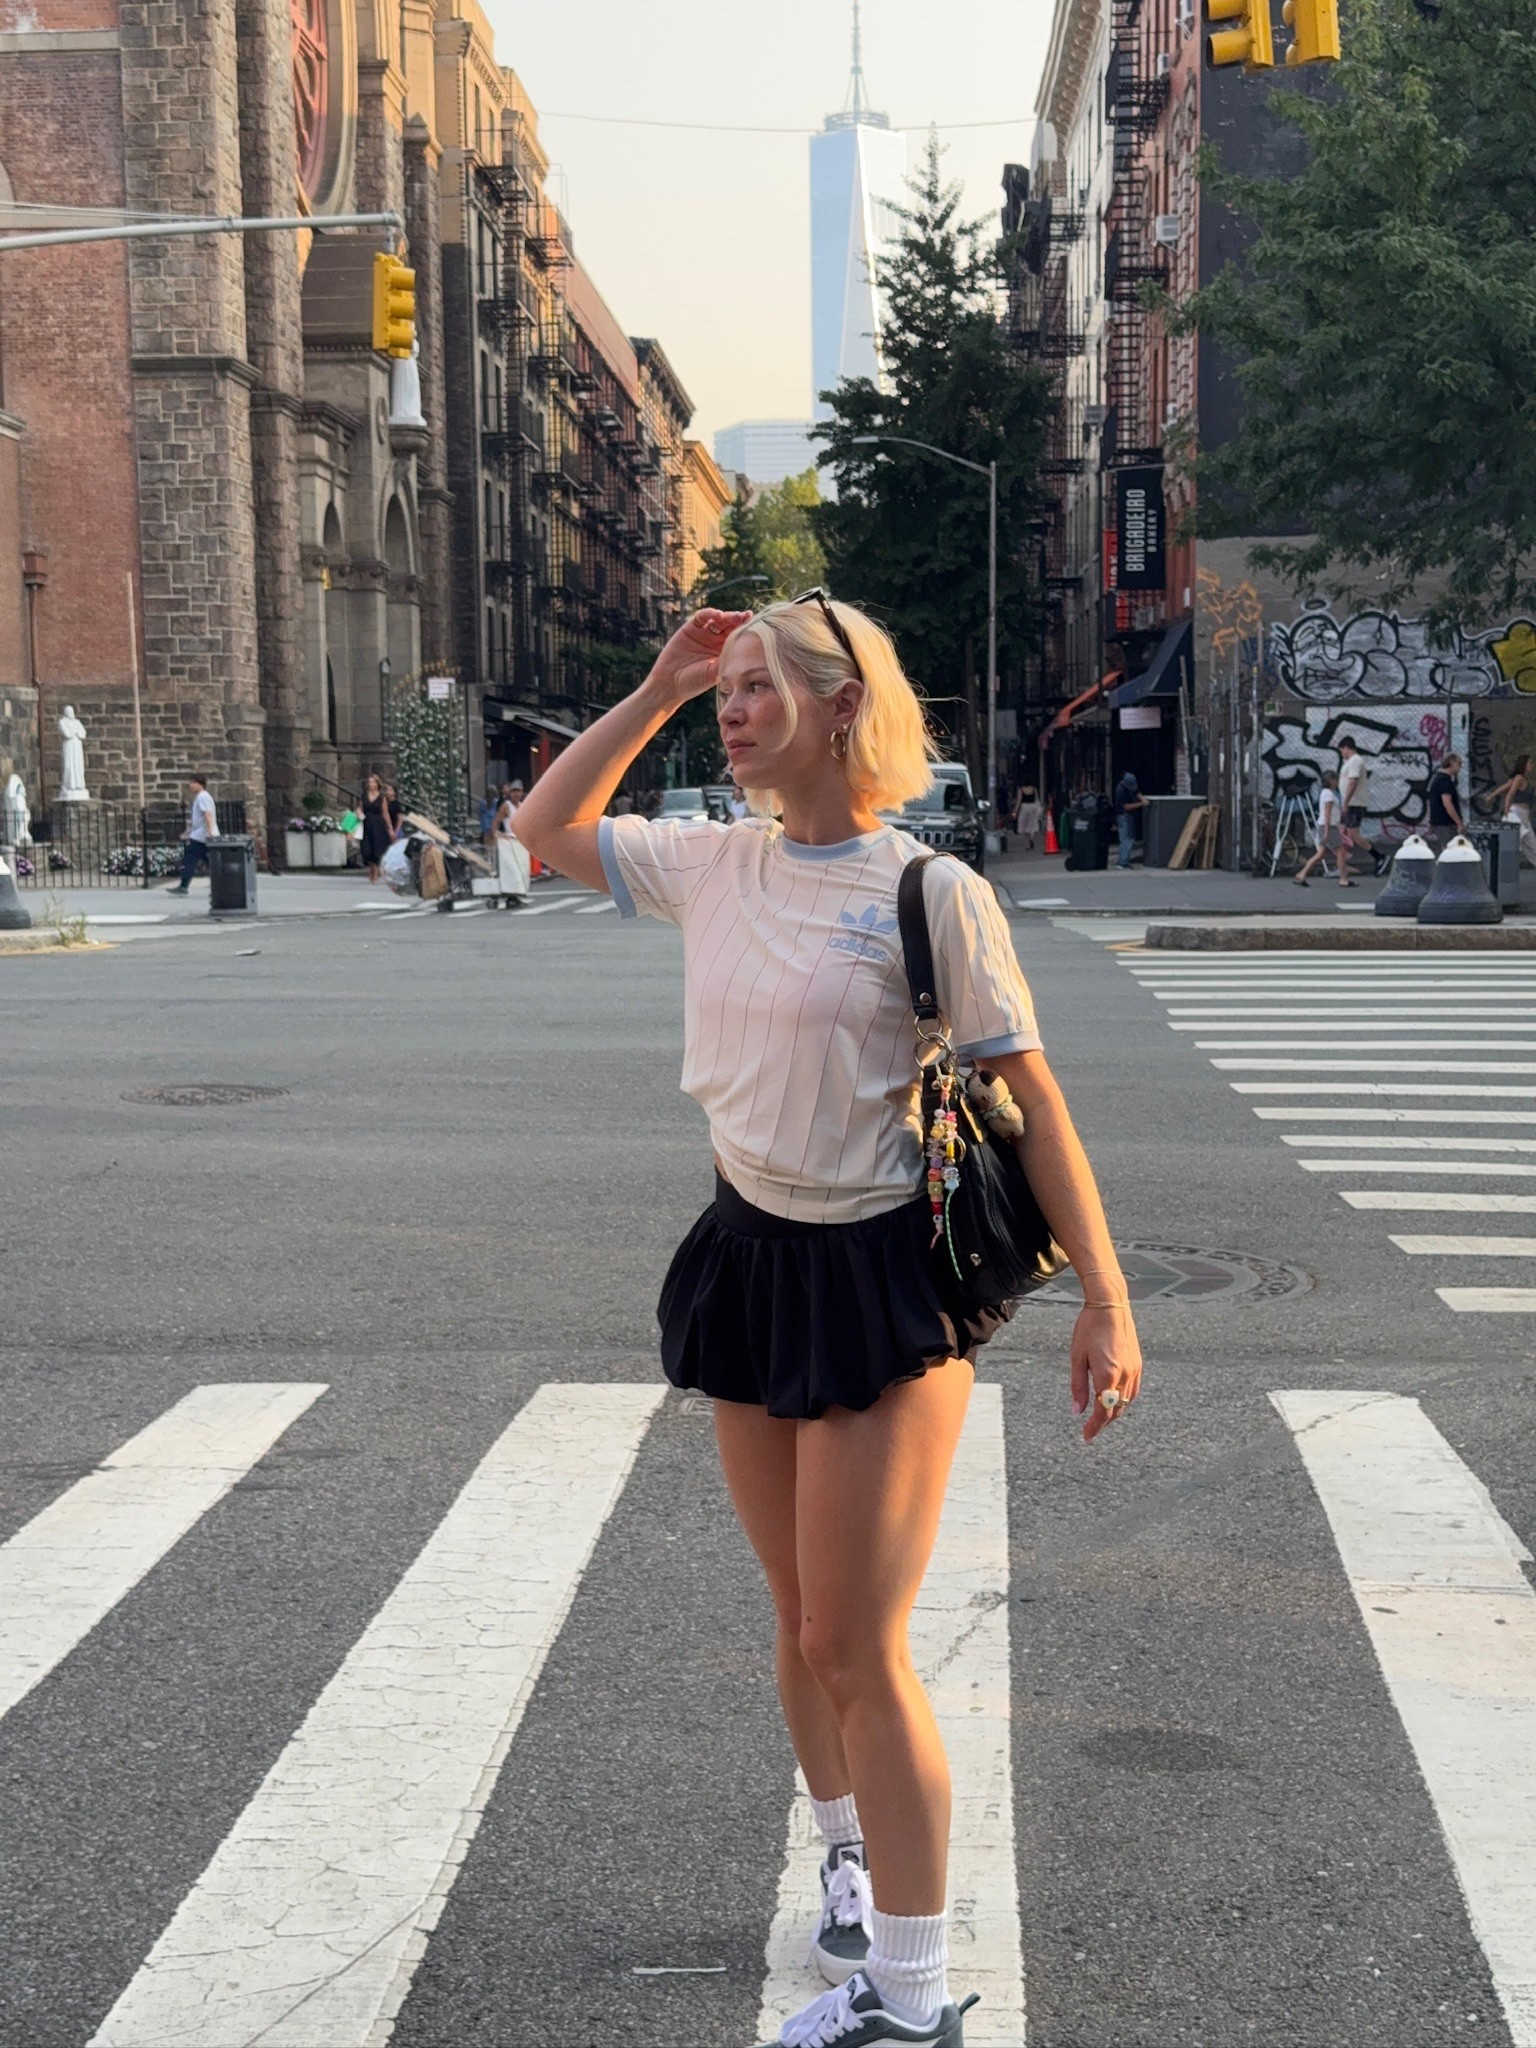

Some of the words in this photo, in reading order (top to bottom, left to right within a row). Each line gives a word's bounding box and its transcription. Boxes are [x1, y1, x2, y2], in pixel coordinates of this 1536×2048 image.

[1126, 489, 1146, 572] BRIGADEIRO
[1147, 510, 1158, 553] BAKERY
[829, 938, 888, 961] adidas
